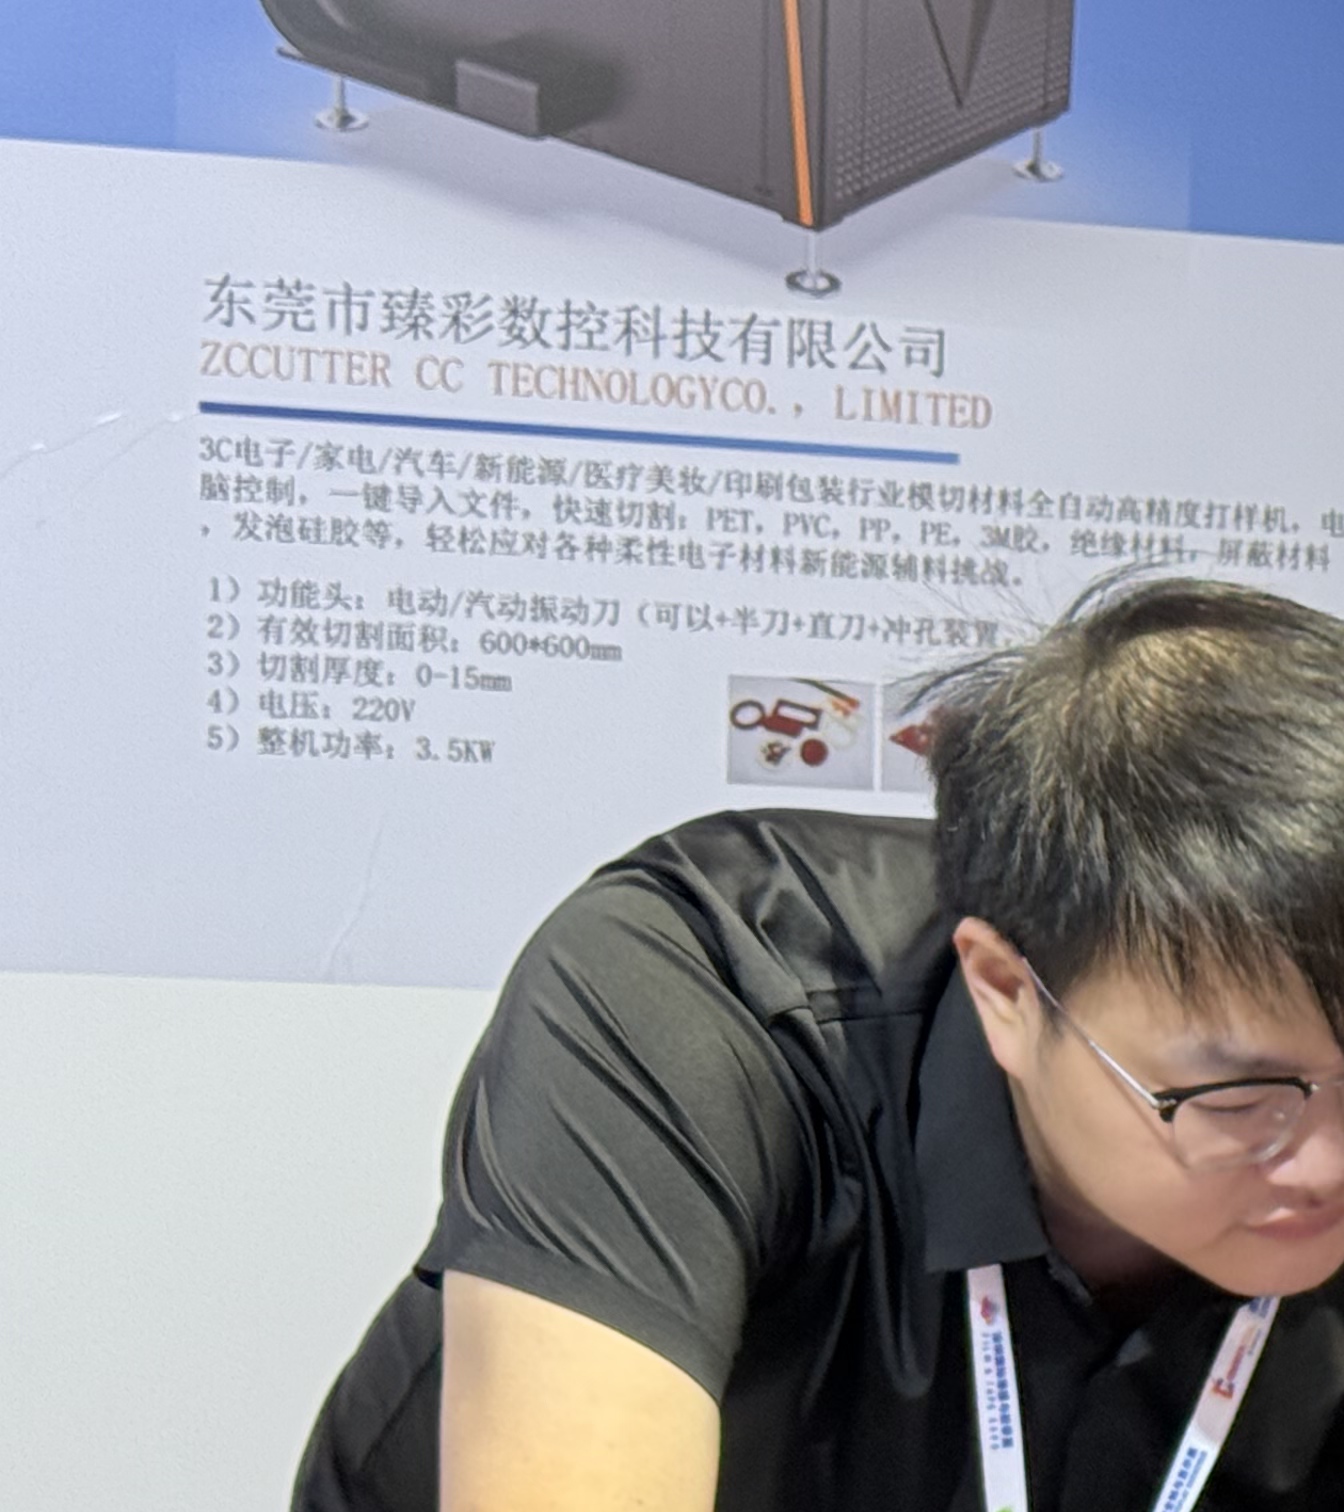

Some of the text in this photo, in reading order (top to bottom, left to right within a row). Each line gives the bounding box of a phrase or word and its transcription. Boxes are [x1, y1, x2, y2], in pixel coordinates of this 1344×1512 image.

[203, 271, 946, 379] 东莞市臻彩数控科技有限公司
[200, 339, 392, 389] ZCCUTTER
[415, 353, 465, 394] CC
[834, 383, 993, 430] LIMITED
